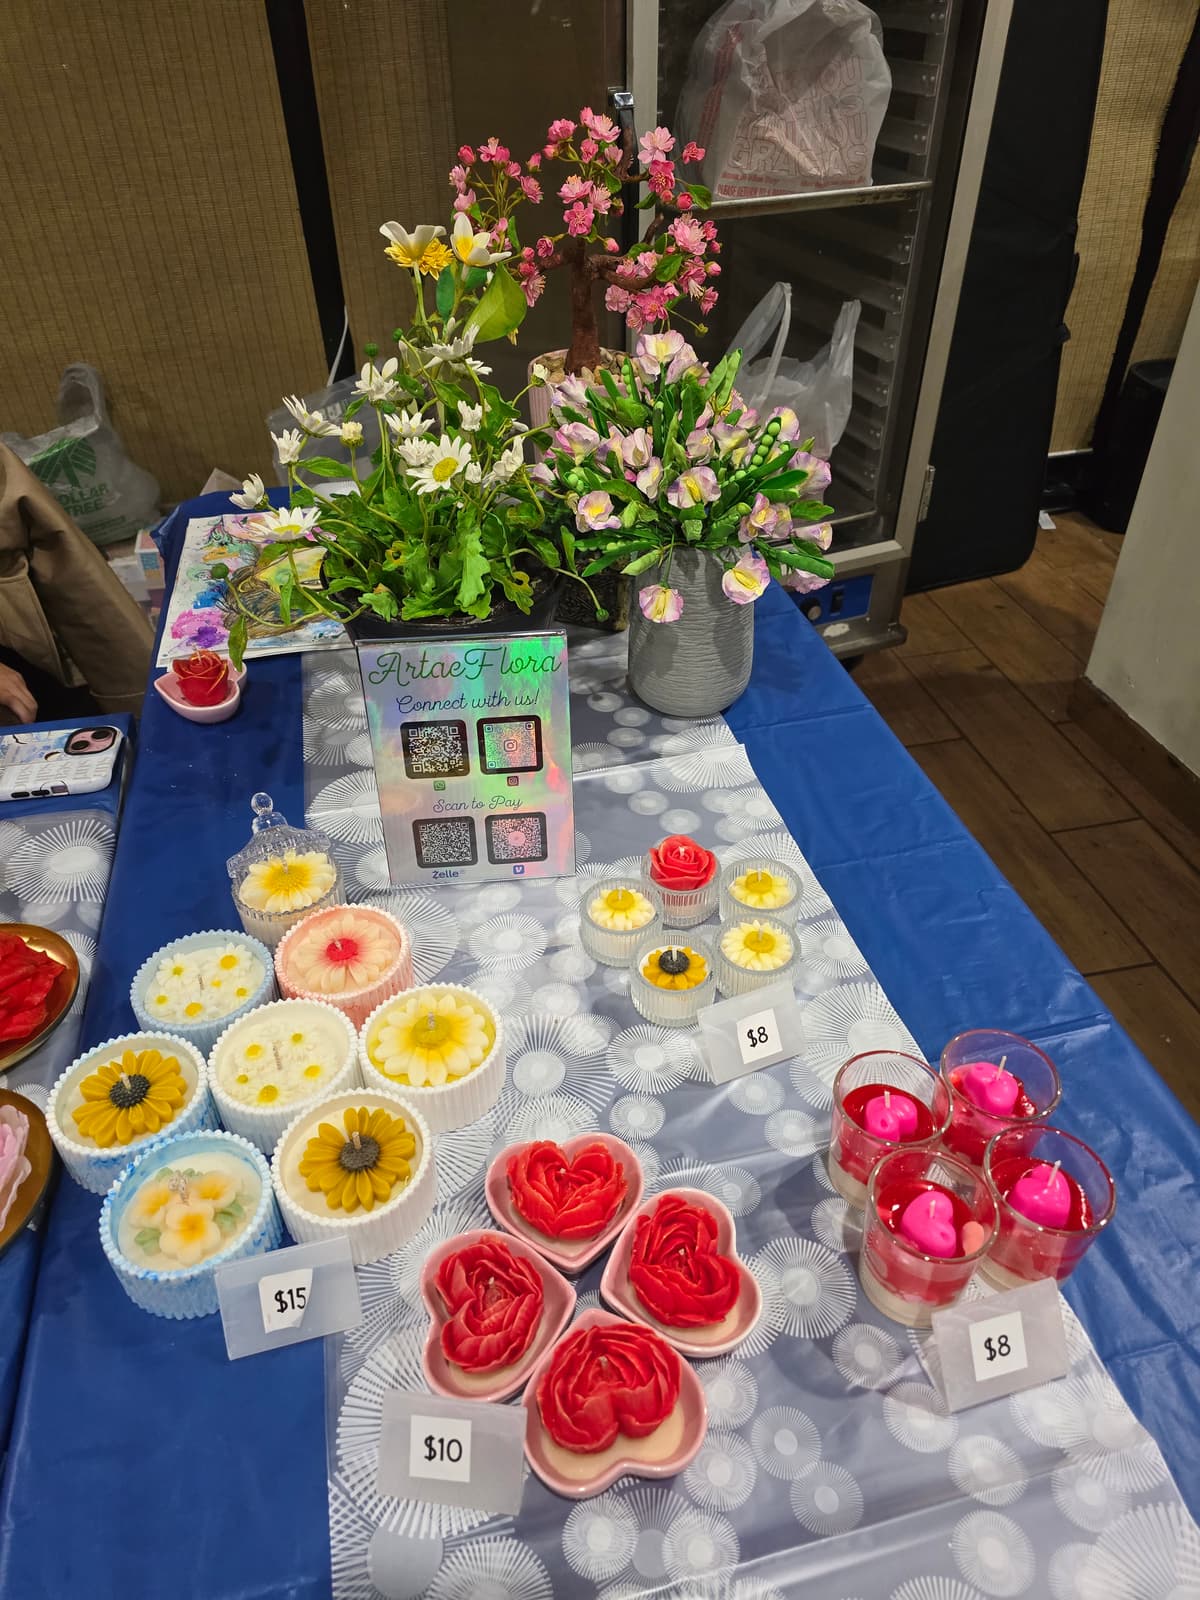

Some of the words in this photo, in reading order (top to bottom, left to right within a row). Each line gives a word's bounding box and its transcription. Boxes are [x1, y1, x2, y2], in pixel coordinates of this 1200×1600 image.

[57, 482, 109, 505] OLLAR
[64, 498, 105, 516] TREE
[396, 692, 467, 713] Connect
[472, 690, 510, 709] with
[515, 688, 539, 706] us!
[433, 799, 469, 813] Scan
[471, 797, 485, 810] to
[489, 795, 523, 810] Pay
[746, 1026, 769, 1048] $8
[274, 1287, 307, 1313] $15
[984, 1334, 1011, 1361] $8
[424, 1434, 463, 1463] $10
